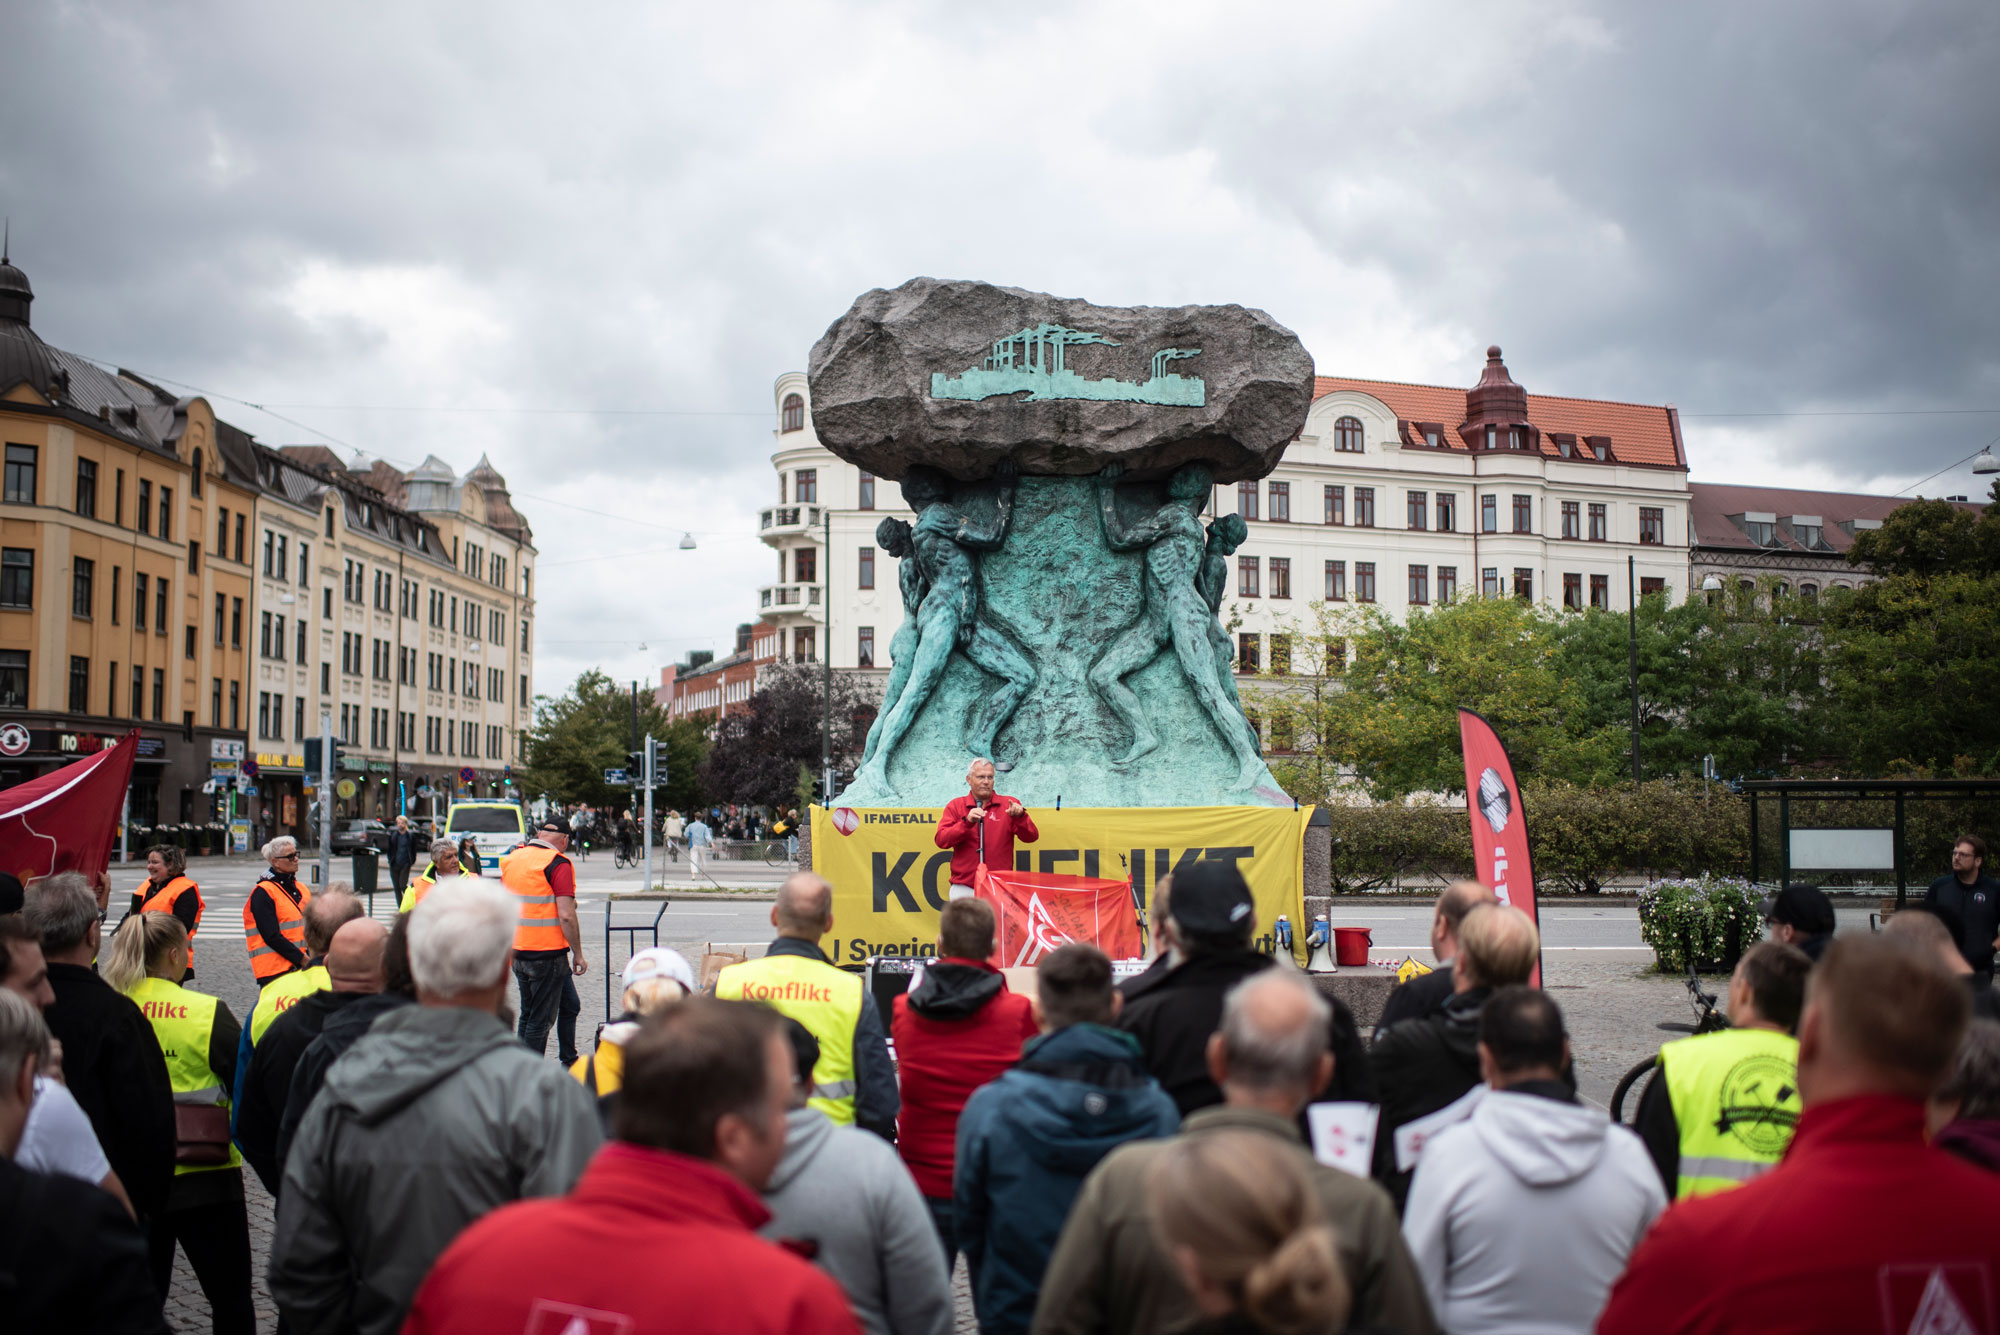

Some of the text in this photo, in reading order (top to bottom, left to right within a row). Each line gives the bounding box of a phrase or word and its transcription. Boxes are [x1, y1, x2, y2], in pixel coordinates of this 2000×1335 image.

[849, 937, 937, 962] Sverig
[742, 982, 832, 1002] Konflikt
[142, 1001, 188, 1019] flikt
